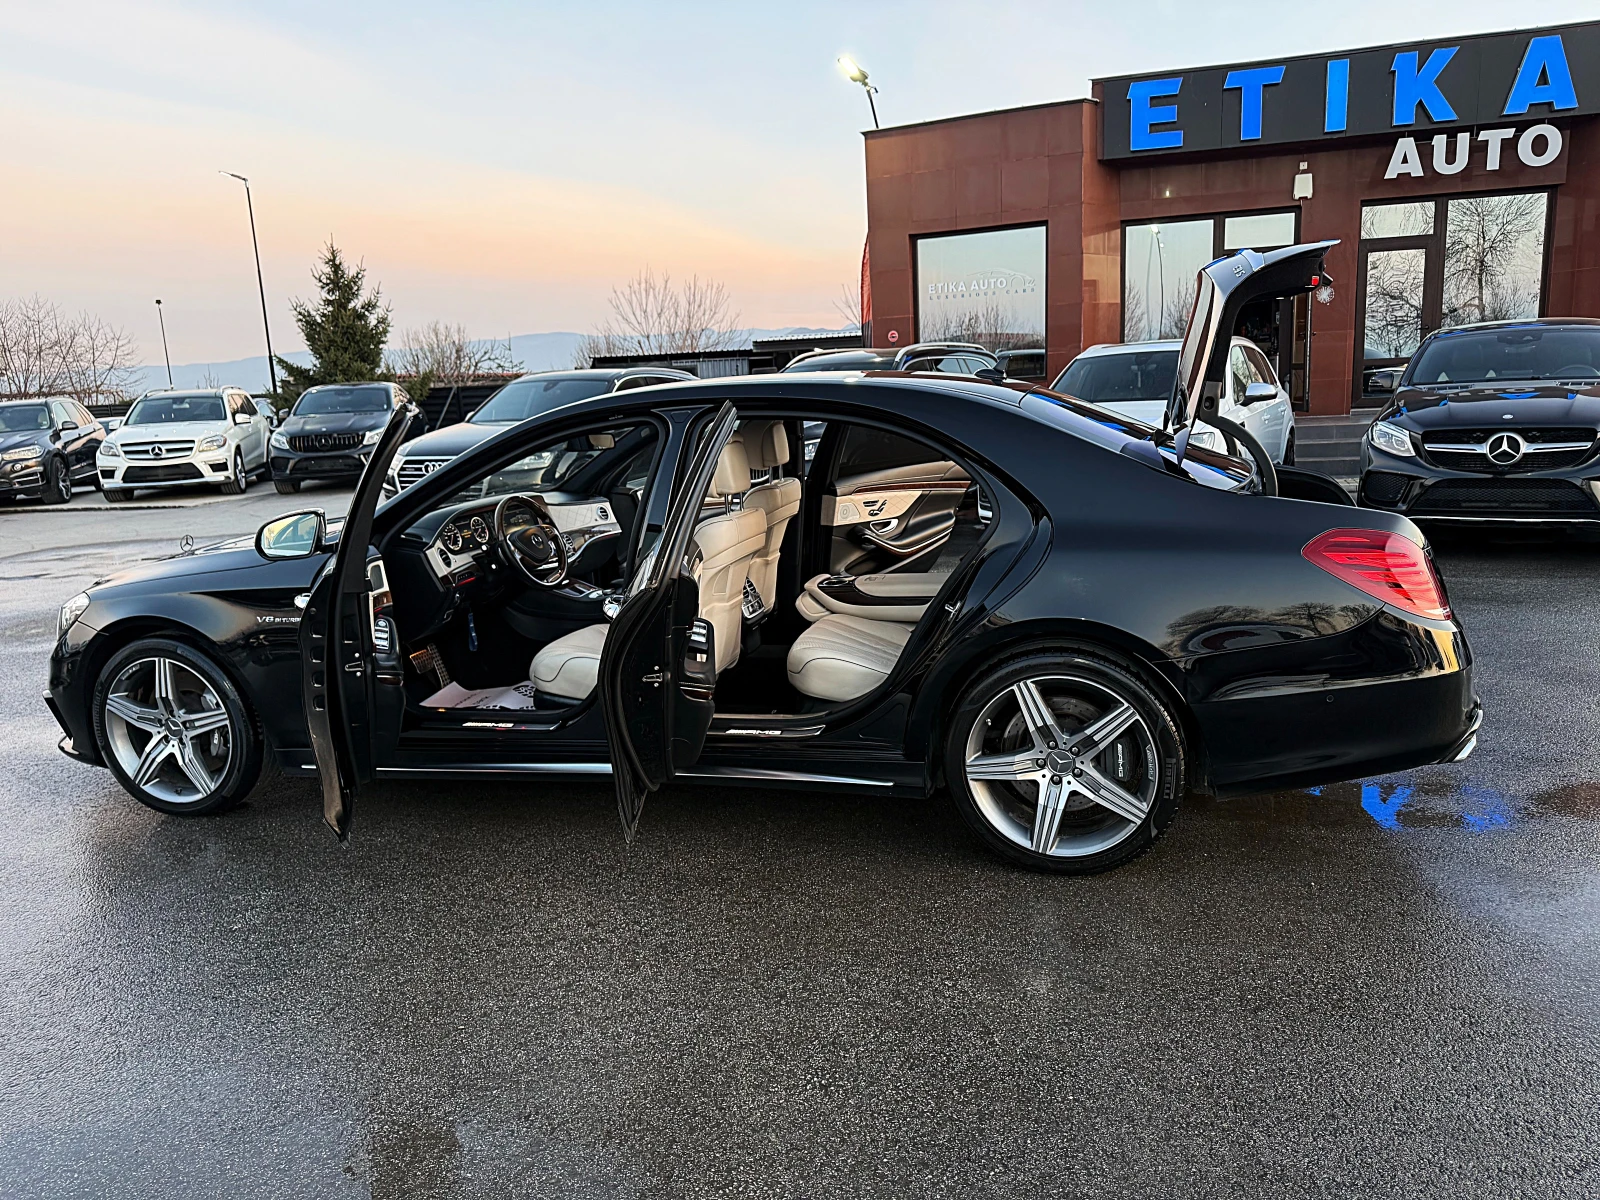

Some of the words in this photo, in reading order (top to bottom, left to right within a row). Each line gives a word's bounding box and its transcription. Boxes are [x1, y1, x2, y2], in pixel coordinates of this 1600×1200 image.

[1126, 34, 1579, 151] ETIKA
[1383, 123, 1563, 180] AUTO
[928, 280, 967, 294] ETIKA
[970, 277, 1007, 291] AUTO
[929, 290, 996, 301] LUXURIOUS
[1005, 287, 1035, 295] CARS
[1163, 757, 1177, 800] PIRELLI
